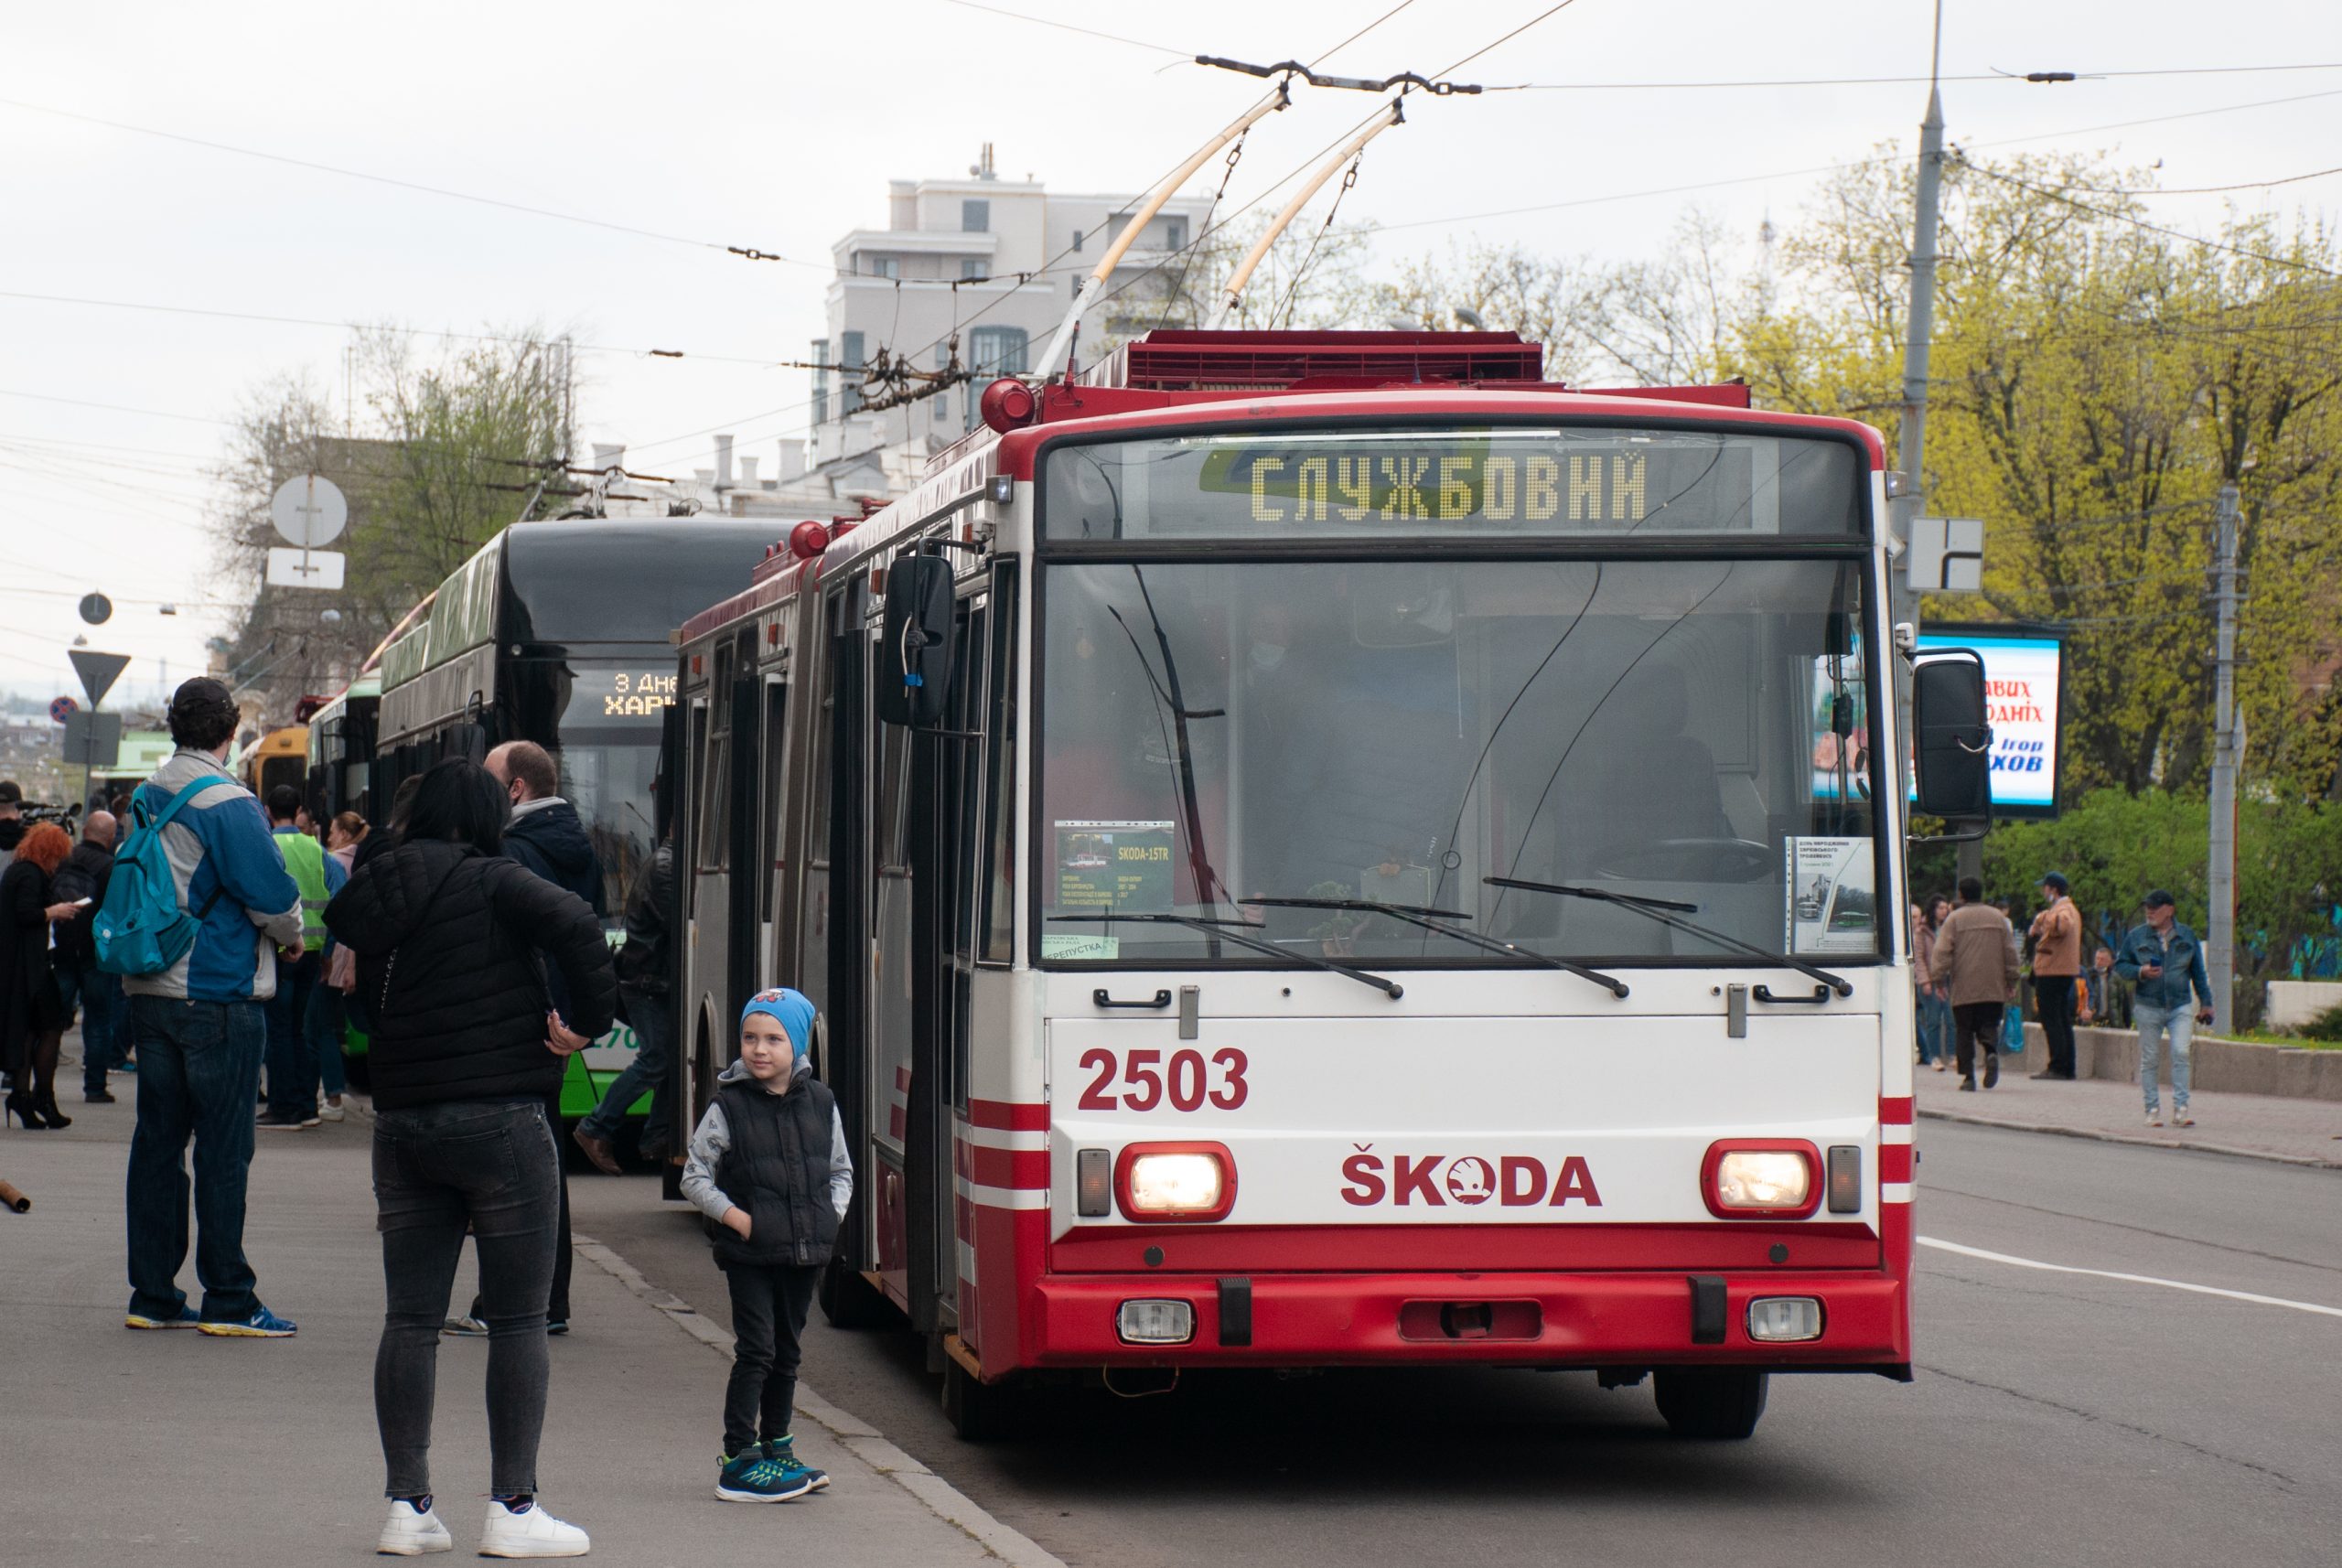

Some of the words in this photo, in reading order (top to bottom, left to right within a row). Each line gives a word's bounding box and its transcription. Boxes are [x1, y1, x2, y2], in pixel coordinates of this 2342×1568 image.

[1252, 448, 1646, 521] СЛУЖБОВИЙ
[1988, 755, 2044, 772] ХОВ
[1118, 847, 1169, 861] SKODA-15TR
[1043, 942, 1102, 959] ЕРЕПУСТКА
[1078, 1047, 1249, 1112] 2503
[1340, 1143, 1603, 1207] ŠKODA
